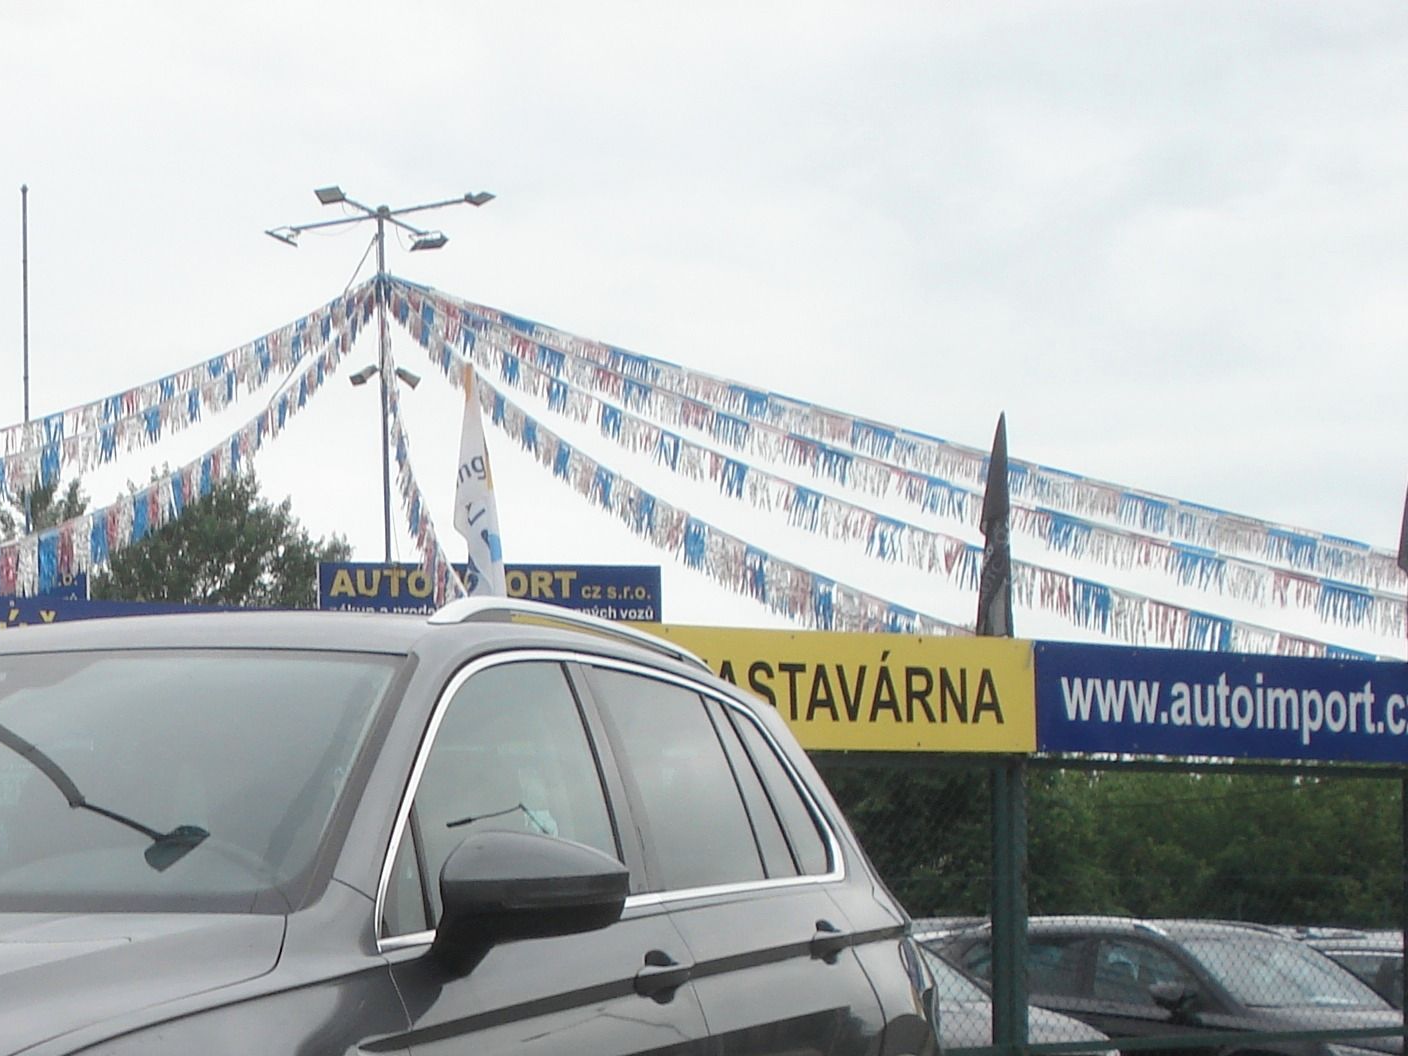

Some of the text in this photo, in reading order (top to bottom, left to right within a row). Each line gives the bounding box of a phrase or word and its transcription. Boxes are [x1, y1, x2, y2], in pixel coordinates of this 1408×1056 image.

[330, 568, 652, 600] AUTOORT cz s.r.o.
[619, 605, 654, 621] vozů
[1060, 672, 1408, 745] www.autoimport.c
